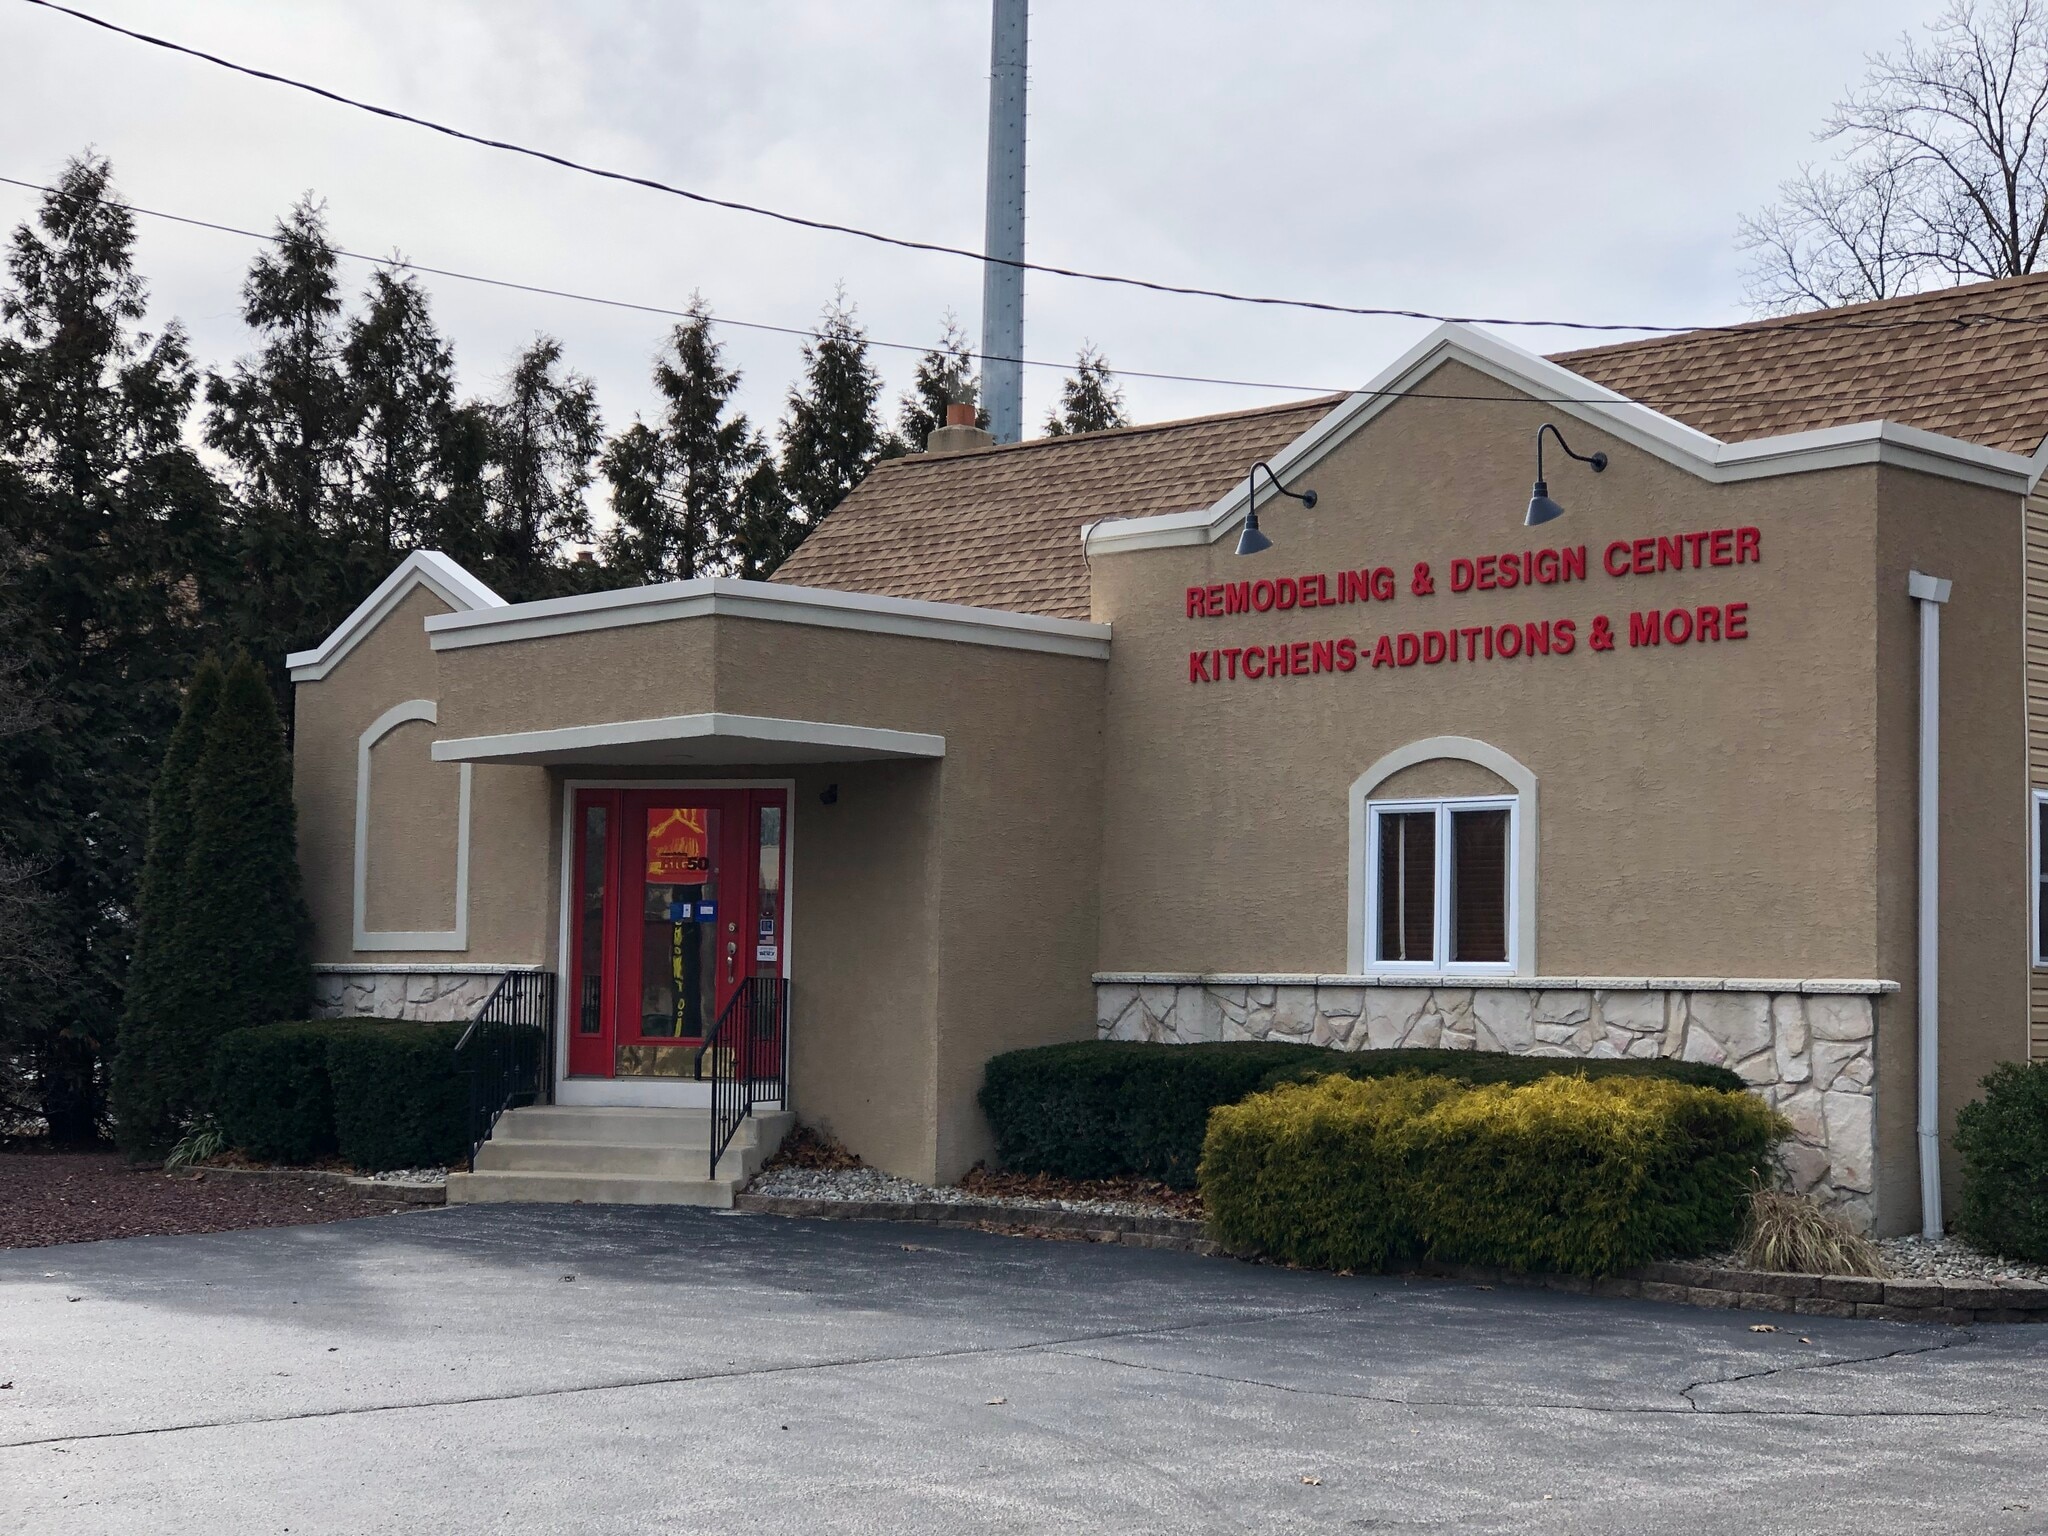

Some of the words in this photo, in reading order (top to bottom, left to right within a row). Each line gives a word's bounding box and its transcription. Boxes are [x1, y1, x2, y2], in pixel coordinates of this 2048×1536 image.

[1186, 566, 1394, 617] REMODELING
[1410, 561, 1434, 597] &
[1450, 545, 1586, 592] DESIGN
[1603, 526, 1761, 577] CENTER
[1188, 618, 1576, 683] KITCHENS-ADDITIONS
[1588, 614, 1614, 651] &
[1628, 602, 1749, 647] MORE
